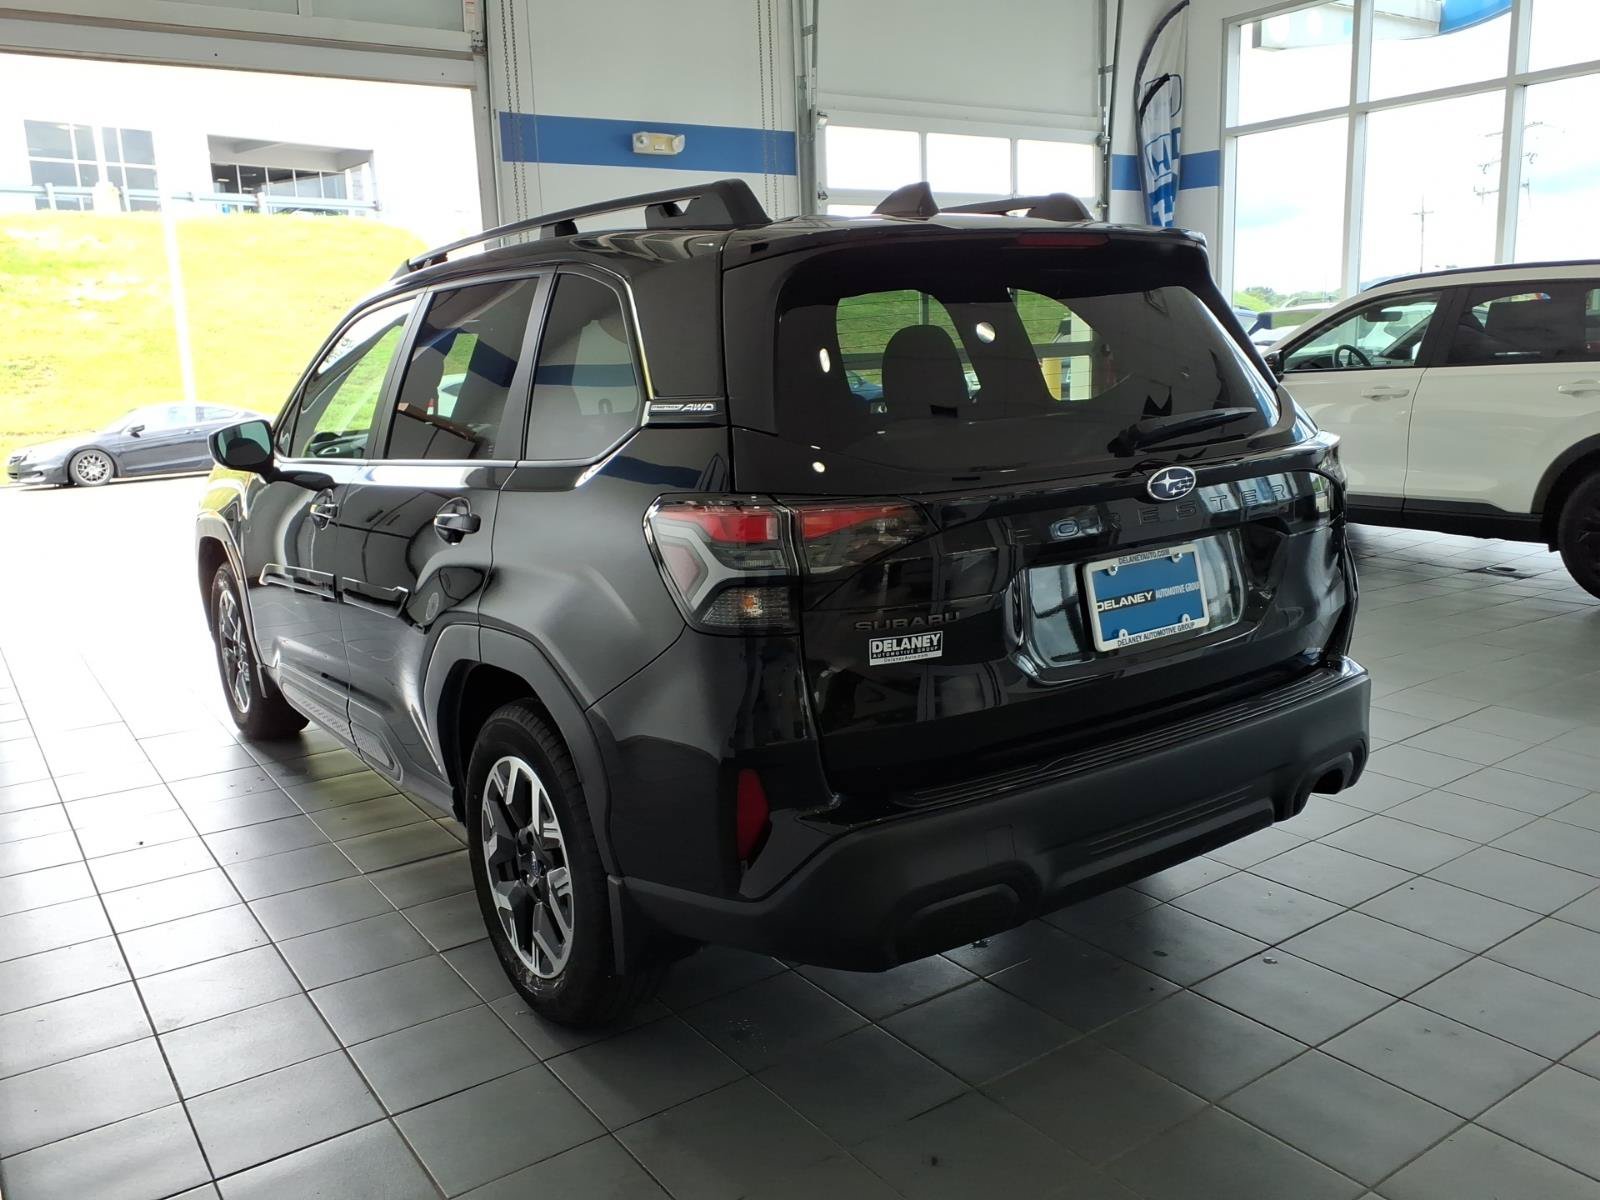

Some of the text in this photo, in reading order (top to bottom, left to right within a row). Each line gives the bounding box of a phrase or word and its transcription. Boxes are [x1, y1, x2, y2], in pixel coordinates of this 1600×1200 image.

[681, 403, 714, 411] AWD
[1096, 590, 1153, 612] DELANEY
[1156, 584, 1185, 599] AUTOMOTIVE
[855, 611, 960, 632] SUBARU
[872, 633, 941, 654] DELANEY
[1117, 622, 1196, 647] DELANEY AUTOMOTIVE GROUP
[872, 648, 914, 658] AUTOMOTIVE
